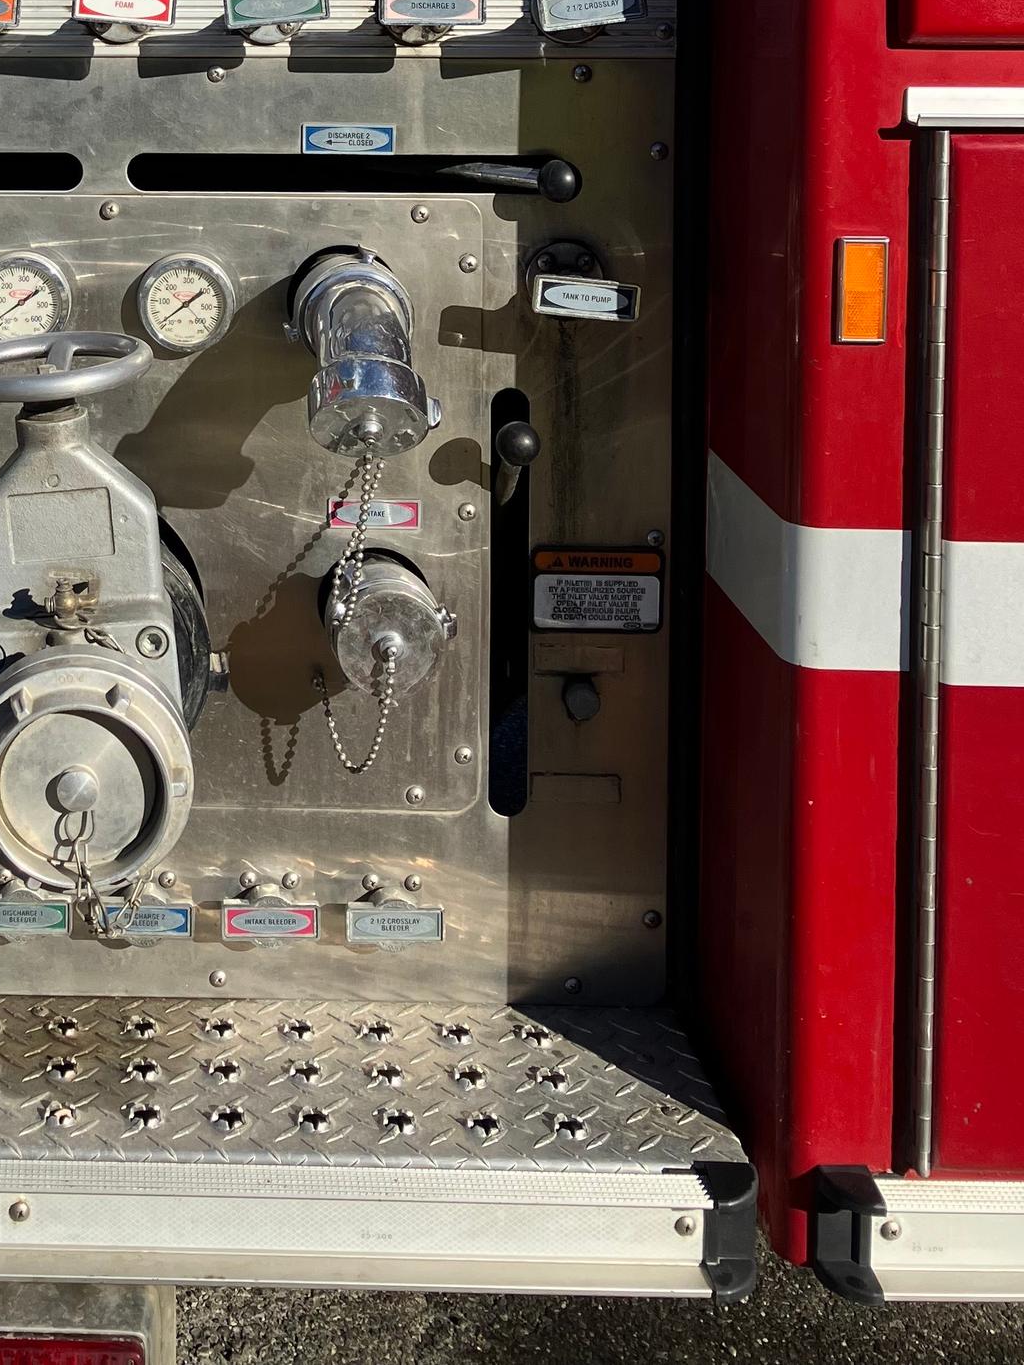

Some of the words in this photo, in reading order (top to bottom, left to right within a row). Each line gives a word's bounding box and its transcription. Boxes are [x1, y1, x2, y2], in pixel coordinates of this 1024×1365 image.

[114, 1, 134, 9] FOAM
[573, 3, 583, 11] 1/2
[562, 292, 579, 301] TANK
[581, 294, 590, 302] TO
[591, 295, 612, 304] PUMP
[568, 556, 633, 568] WARNING
